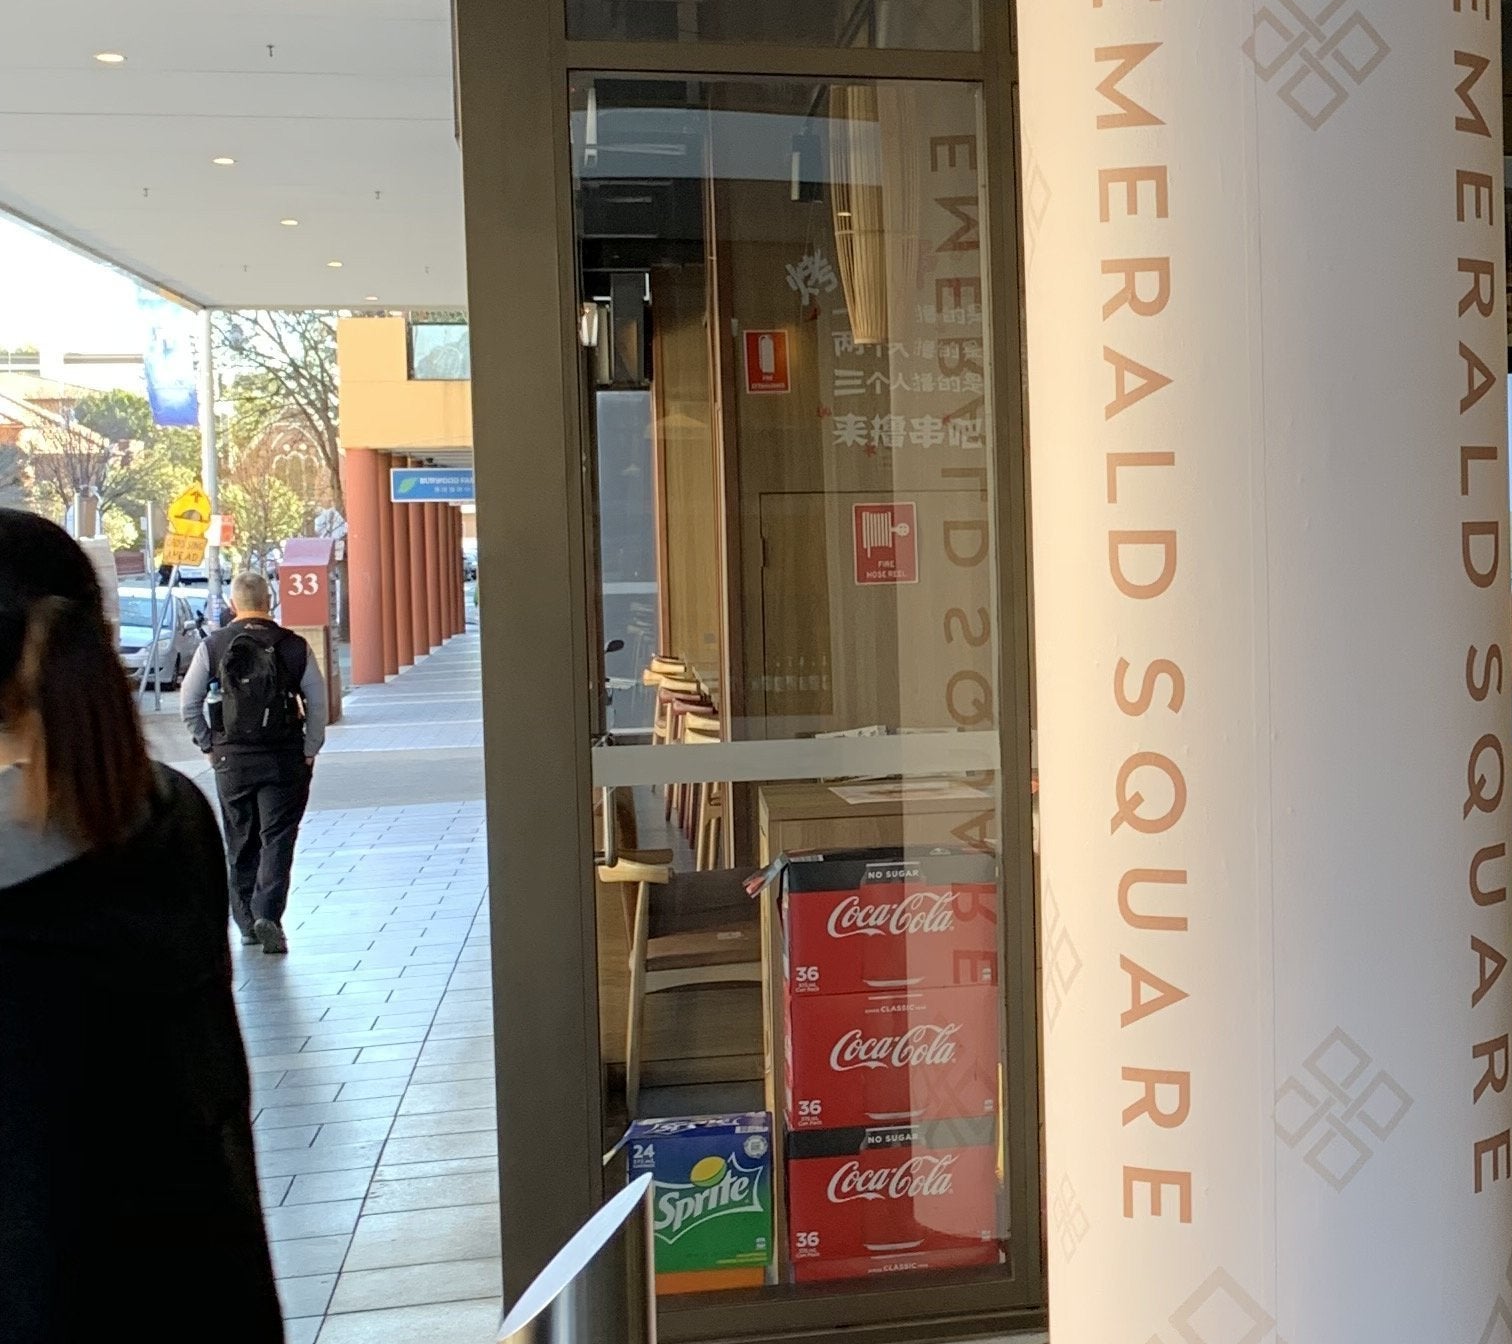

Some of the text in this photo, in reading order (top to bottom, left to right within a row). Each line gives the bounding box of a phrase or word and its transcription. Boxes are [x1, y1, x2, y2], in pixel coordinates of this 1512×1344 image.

[878, 559, 896, 569] FIRE
[865, 570, 887, 579] HOSE
[288, 572, 319, 596] 33
[867, 868, 920, 880] NO SUGAR
[826, 891, 961, 939] Coca-Cola
[1461, 644, 1512, 1195] SQUARE
[1110, 657, 1193, 1225] SQUARE
[795, 966, 820, 982] 36
[880, 1004, 915, 1014] CLASSIC
[829, 1022, 964, 1072] Coca-Cola
[797, 1099, 823, 1116] 36
[867, 1133, 920, 1144] NO SUGAR
[632, 1143, 656, 1159] 24
[826, 1154, 961, 1204] Coca-Cola
[653, 1169, 750, 1233] Sprite
[795, 1231, 820, 1247] 36
